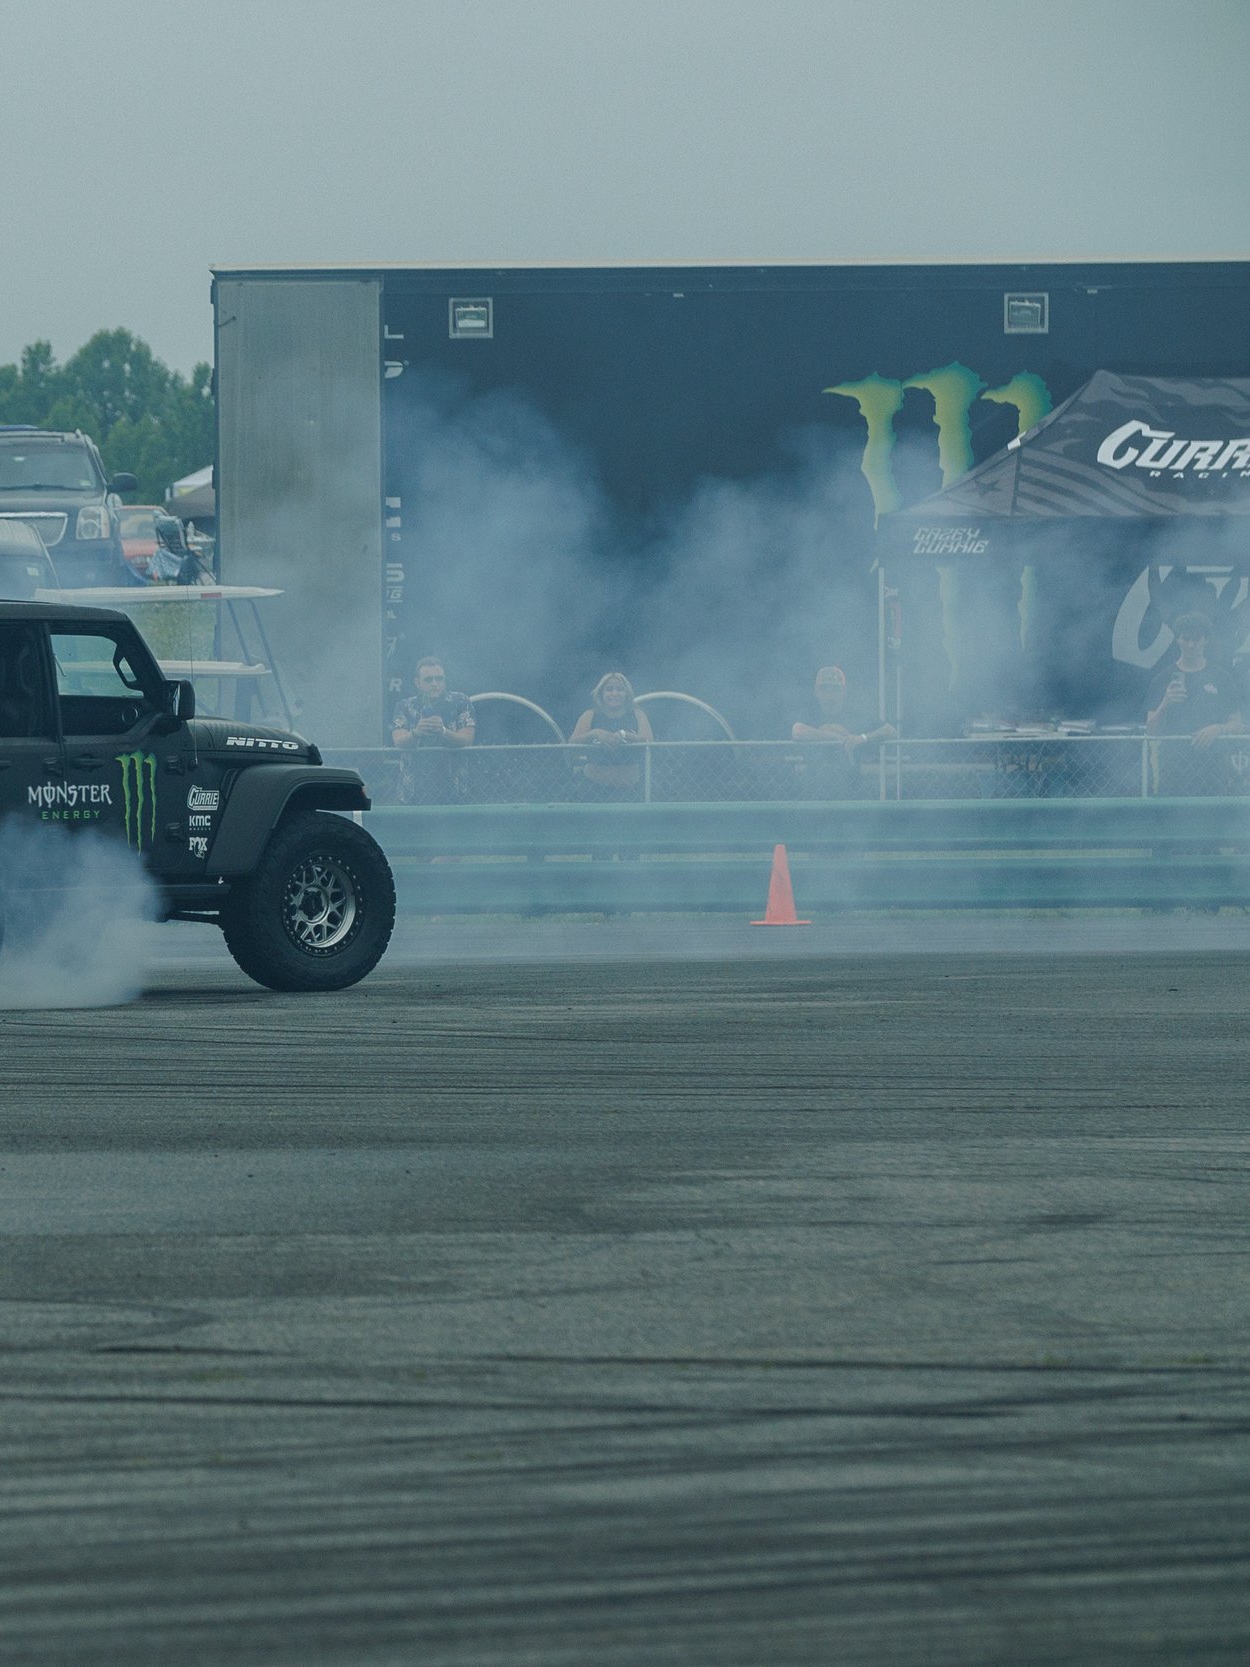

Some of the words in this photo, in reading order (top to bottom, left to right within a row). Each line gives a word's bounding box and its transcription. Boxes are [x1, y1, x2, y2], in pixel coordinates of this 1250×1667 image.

[226, 736, 299, 750] NITTO
[27, 781, 113, 808] MONSTER
[188, 787, 218, 807] CURRIE
[41, 810, 100, 820] ENERGY
[189, 815, 211, 827] KMC
[188, 836, 208, 858] FOX
